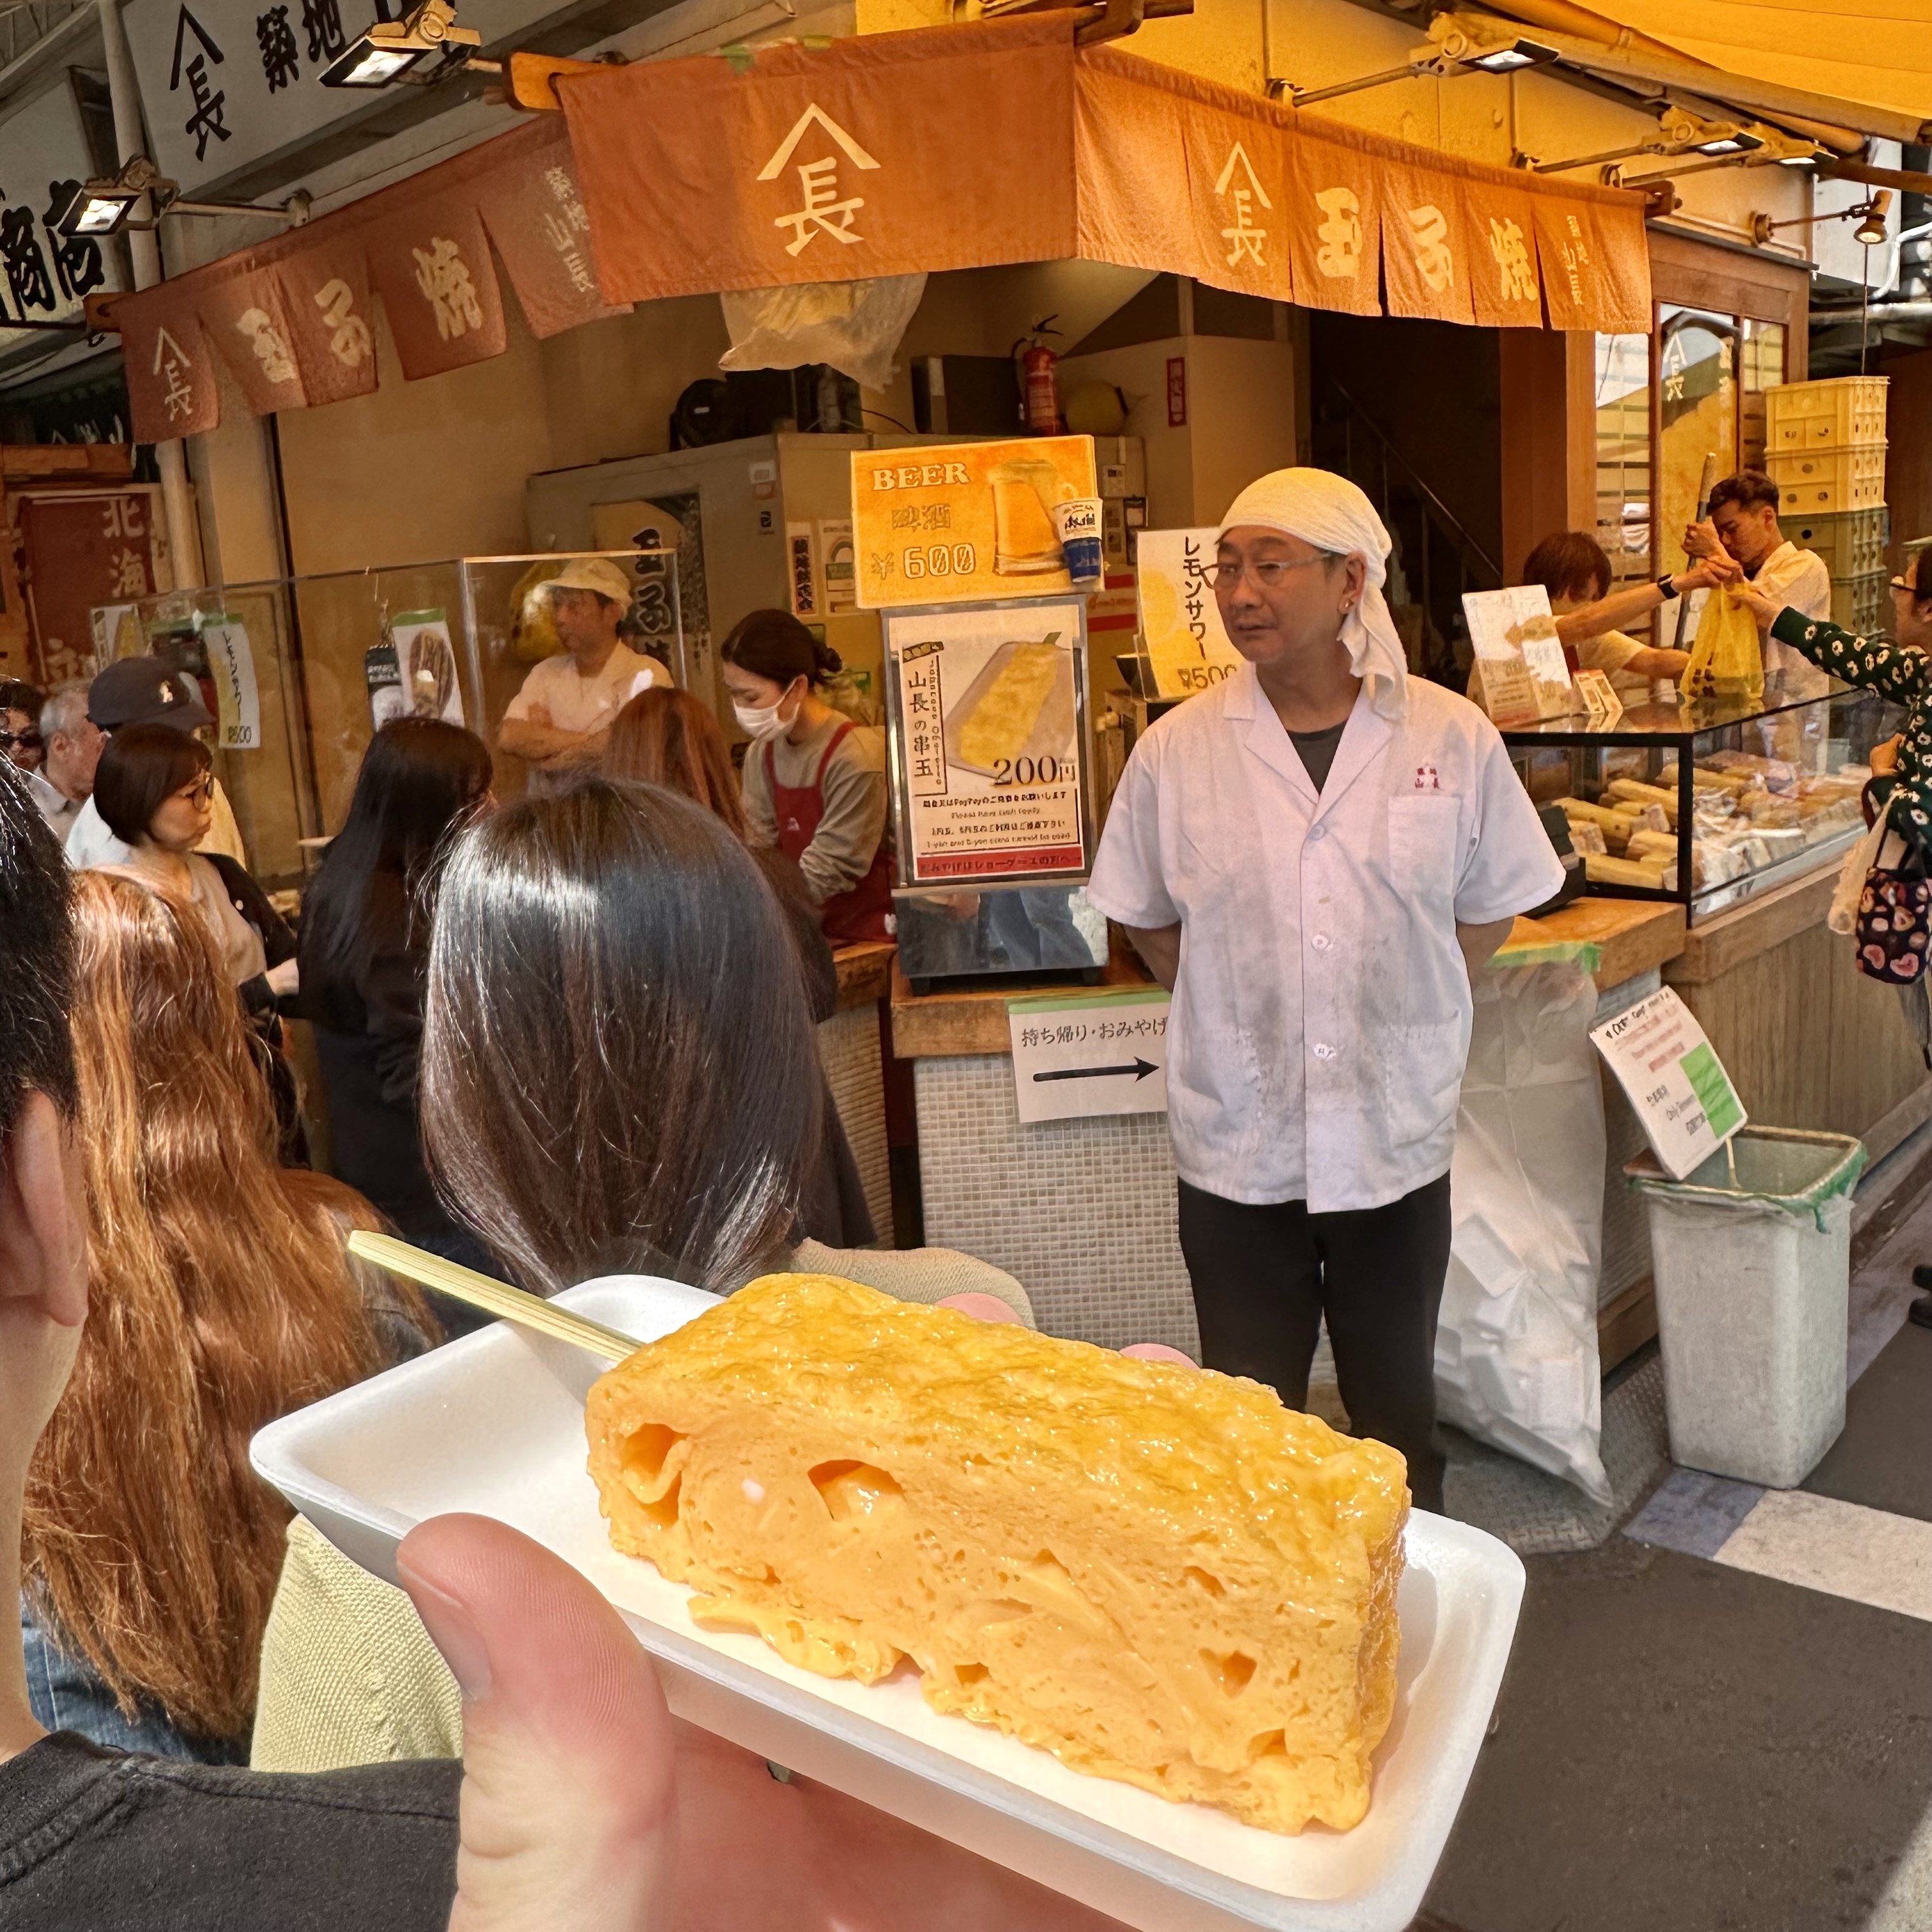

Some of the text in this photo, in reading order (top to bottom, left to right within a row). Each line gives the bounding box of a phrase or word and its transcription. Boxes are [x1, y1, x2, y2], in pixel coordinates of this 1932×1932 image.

[872, 461, 971, 491] BEER
[1183, 536, 1207, 660] レモンサワー
[908, 671, 934, 778] 山長の串玉
[992, 755, 1076, 785] 200円
[1022, 1016, 1169, 1047] 持ち帰り・おみやげ
